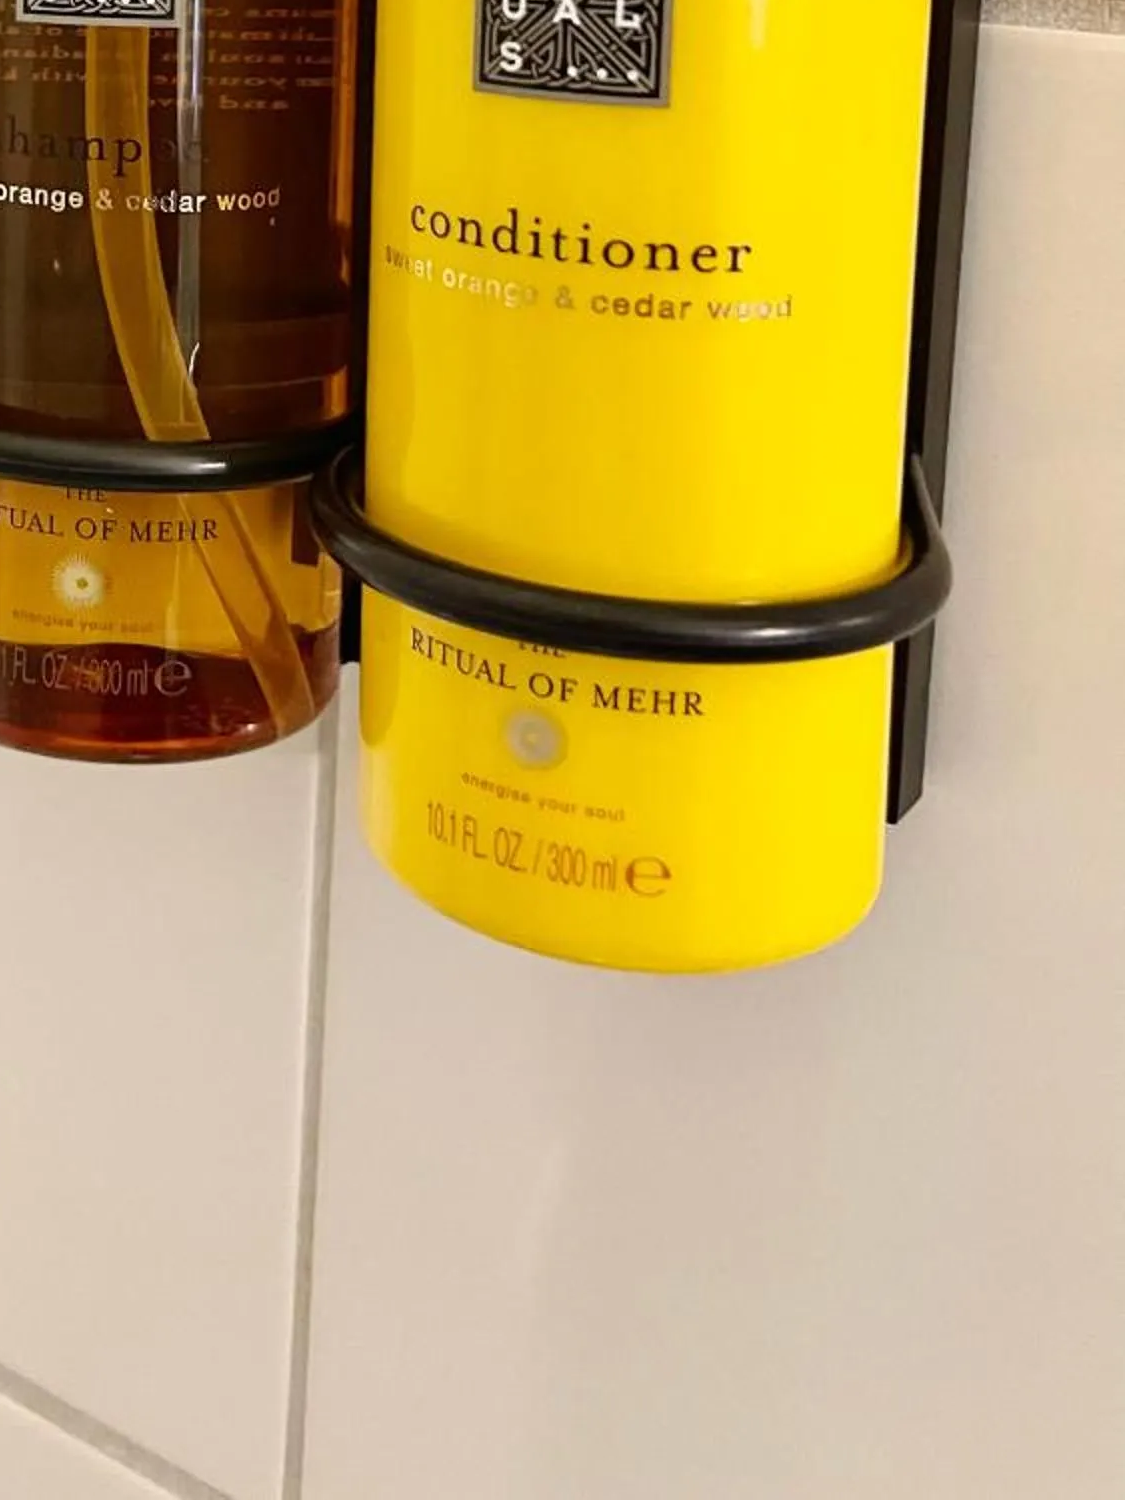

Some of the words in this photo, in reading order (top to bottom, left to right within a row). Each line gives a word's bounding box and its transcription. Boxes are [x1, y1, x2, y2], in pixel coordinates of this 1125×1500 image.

[95, 188, 114, 211] &
[125, 190, 208, 213] cedar
[216, 186, 281, 212] wood
[410, 206, 753, 274] conditioner
[441, 266, 539, 309] orange
[554, 284, 575, 310] &
[589, 293, 693, 320] cedar
[707, 293, 794, 323] wood
[74, 516, 118, 542] OF
[129, 518, 219, 543] MEHR
[410, 626, 516, 690] RITUAL
[528, 672, 578, 702] OF
[591, 682, 705, 716] MEHR
[427, 800, 457, 846] 10.1
[546, 843, 587, 887] 300
